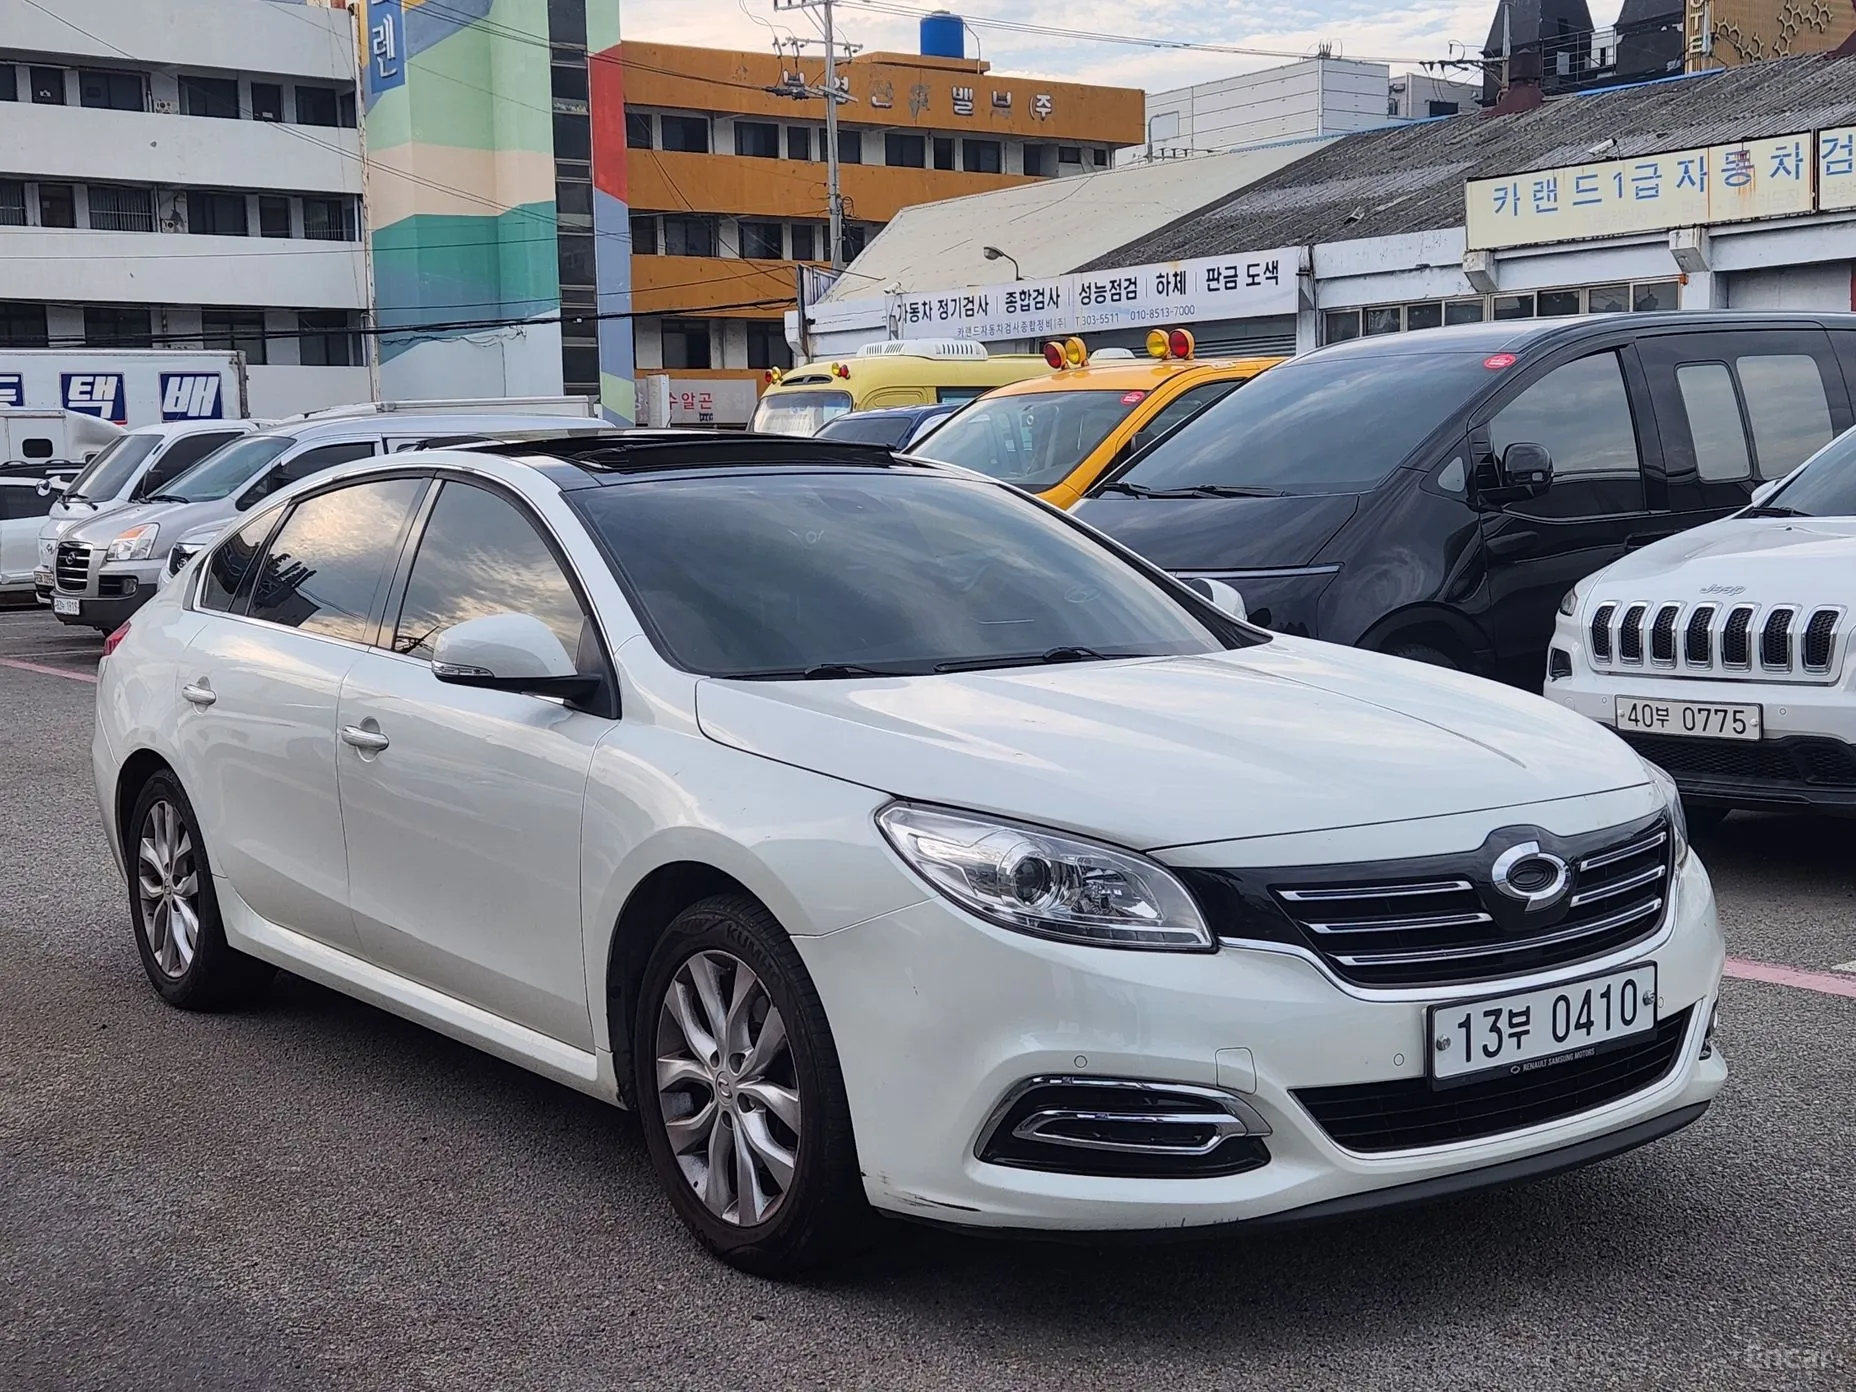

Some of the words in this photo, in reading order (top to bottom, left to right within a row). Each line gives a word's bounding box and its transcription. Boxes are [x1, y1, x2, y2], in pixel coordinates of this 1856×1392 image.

[371, 0, 399, 78] 렌
[897, 299, 933, 324] 자동차
[937, 294, 990, 321] 정기검사
[1005, 286, 1061, 313] 종합검사
[1078, 276, 1138, 306] 성능점검
[1156, 270, 1187, 297] 하체
[1205, 265, 1239, 292] 판금
[1245, 260, 1279, 287] 도색
[1130, 304, 1196, 321] 010-8513-7000
[1699, 583, 1747, 597] Jeep
[1627, 702, 1670, 728] 40부
[1682, 706, 1747, 734] 0775
[1457, 1005, 1531, 1063] 13부
[1551, 978, 1638, 1043] 0410
[1522, 1059, 1548, 1072] RENAULT
[1548, 1052, 1574, 1067] SAMSUNG
[1574, 1047, 1596, 1060] MOTORS
